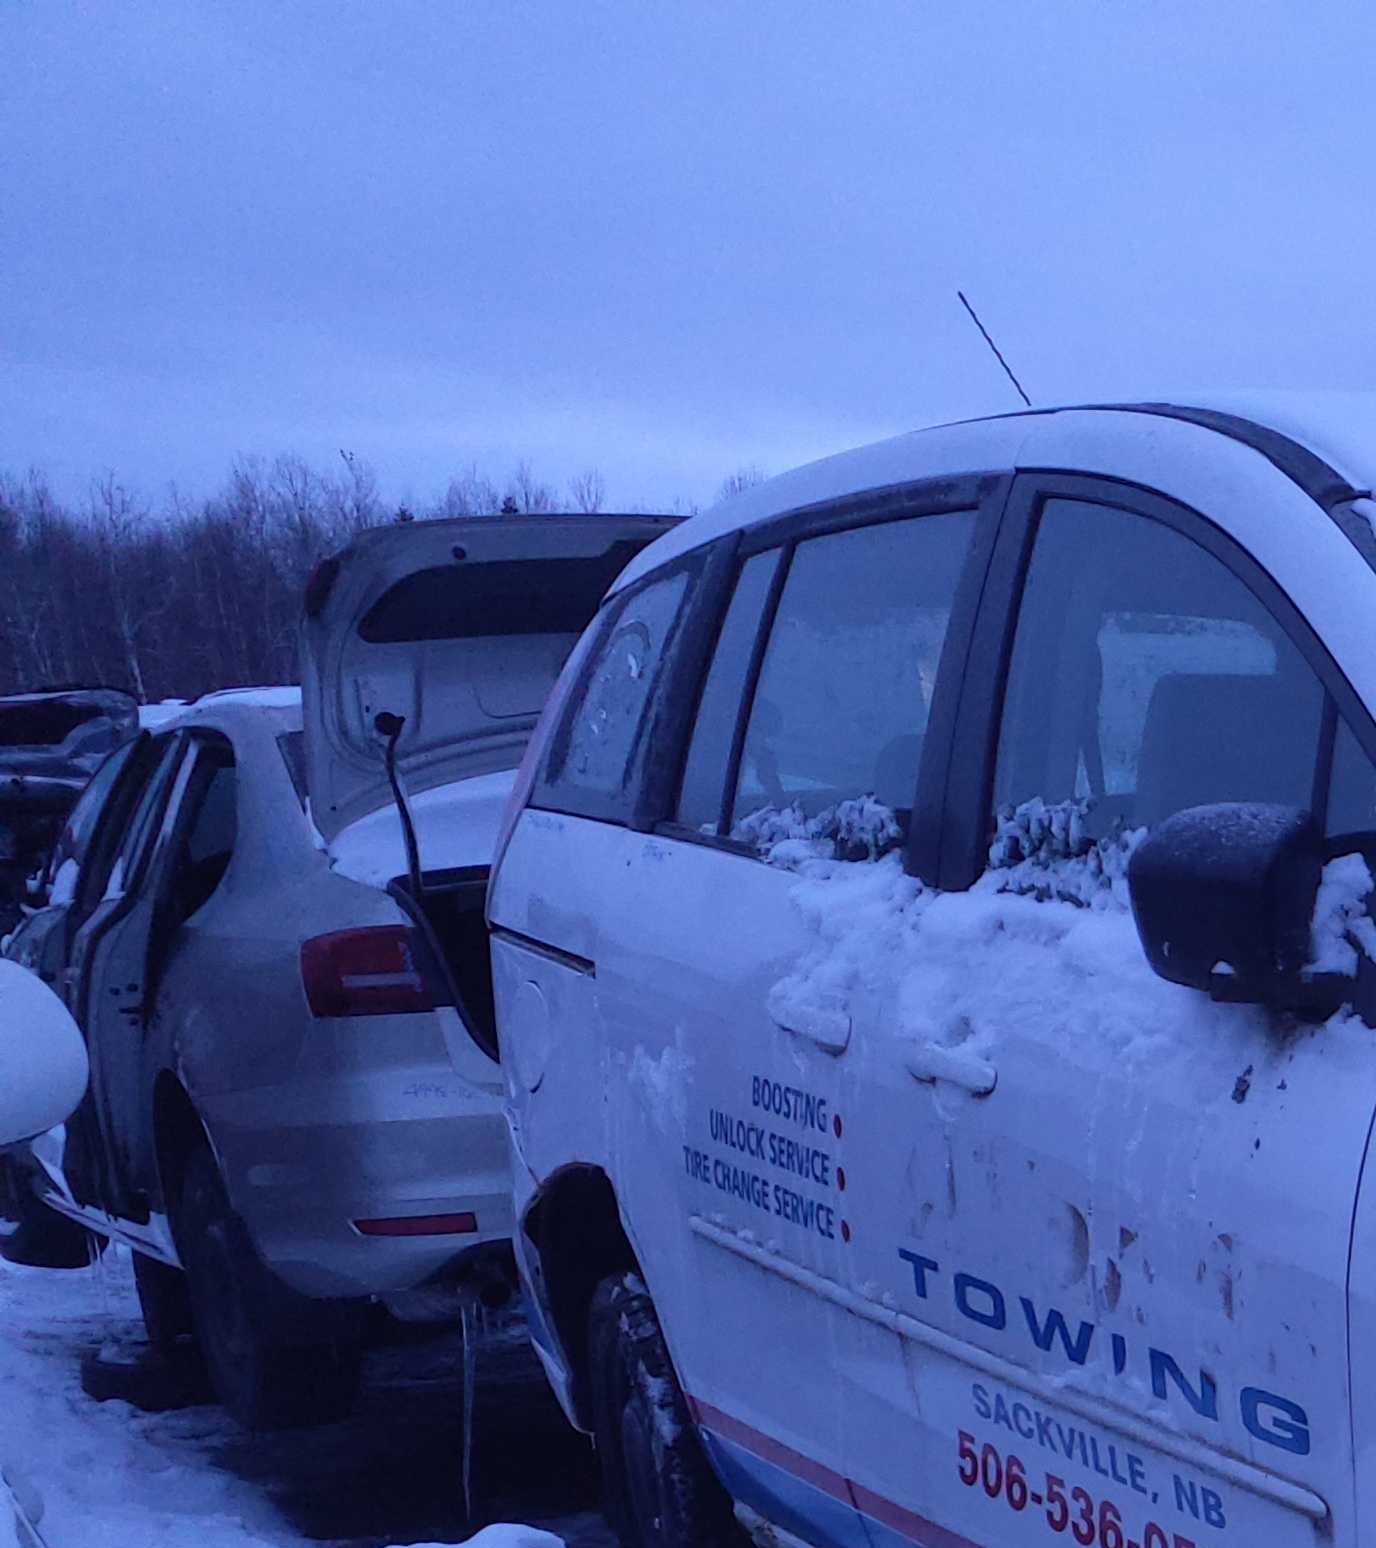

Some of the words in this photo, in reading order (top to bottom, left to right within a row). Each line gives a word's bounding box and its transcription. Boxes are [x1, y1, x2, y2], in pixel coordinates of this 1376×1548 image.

[709, 1109, 765, 1160] UNLOCK
[769, 1132, 830, 1186] SERVICE
[752, 1076, 828, 1133] BOOSTING
[683, 1145, 711, 1184] TIRE
[714, 1159, 770, 1213] CHANGE
[774, 1184, 835, 1240] SERVICE
[898, 1247, 1311, 1456] TOWING
[971, 1383, 1159, 1504] SACKVILLE,
[1172, 1473, 1227, 1529] NB
